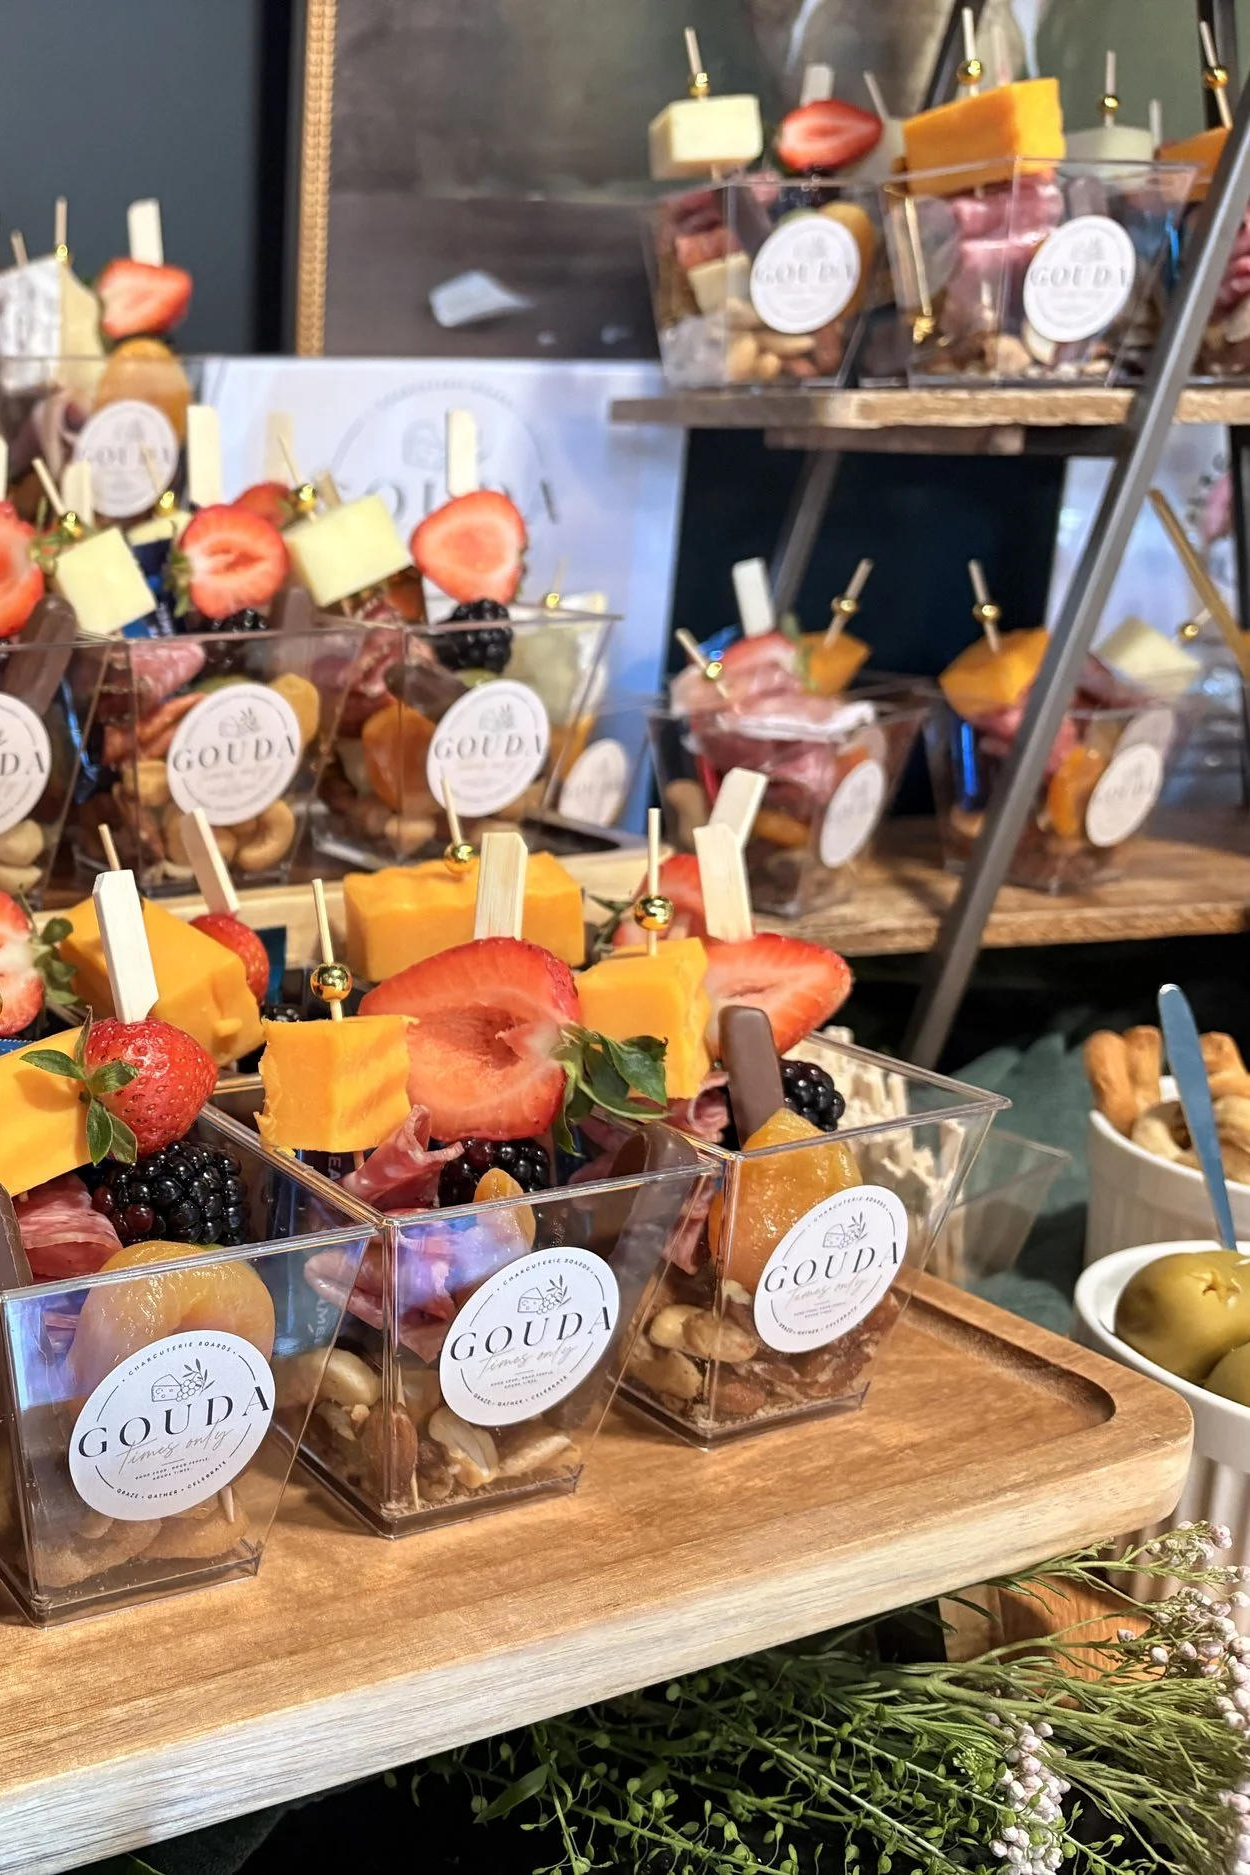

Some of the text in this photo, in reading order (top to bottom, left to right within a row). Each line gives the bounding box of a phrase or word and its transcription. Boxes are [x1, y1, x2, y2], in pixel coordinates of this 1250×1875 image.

[173, 735, 296, 772] GOUDA
[434, 734, 542, 760] GOUDA
[503, 1258, 590, 1286] CHARCUTERIE BOARDS
[764, 1241, 898, 1293] GOUDA
[450, 1306, 611, 1361] GOUDA
[536, 1335, 578, 1365] only
[129, 1341, 231, 1376] CHARCUTERIE BOARDS
[78, 1385, 270, 1457] GOUDA
[186, 1418, 234, 1450] only
[117, 1460, 227, 1499] GRAZE GATHER CELEBRATE
